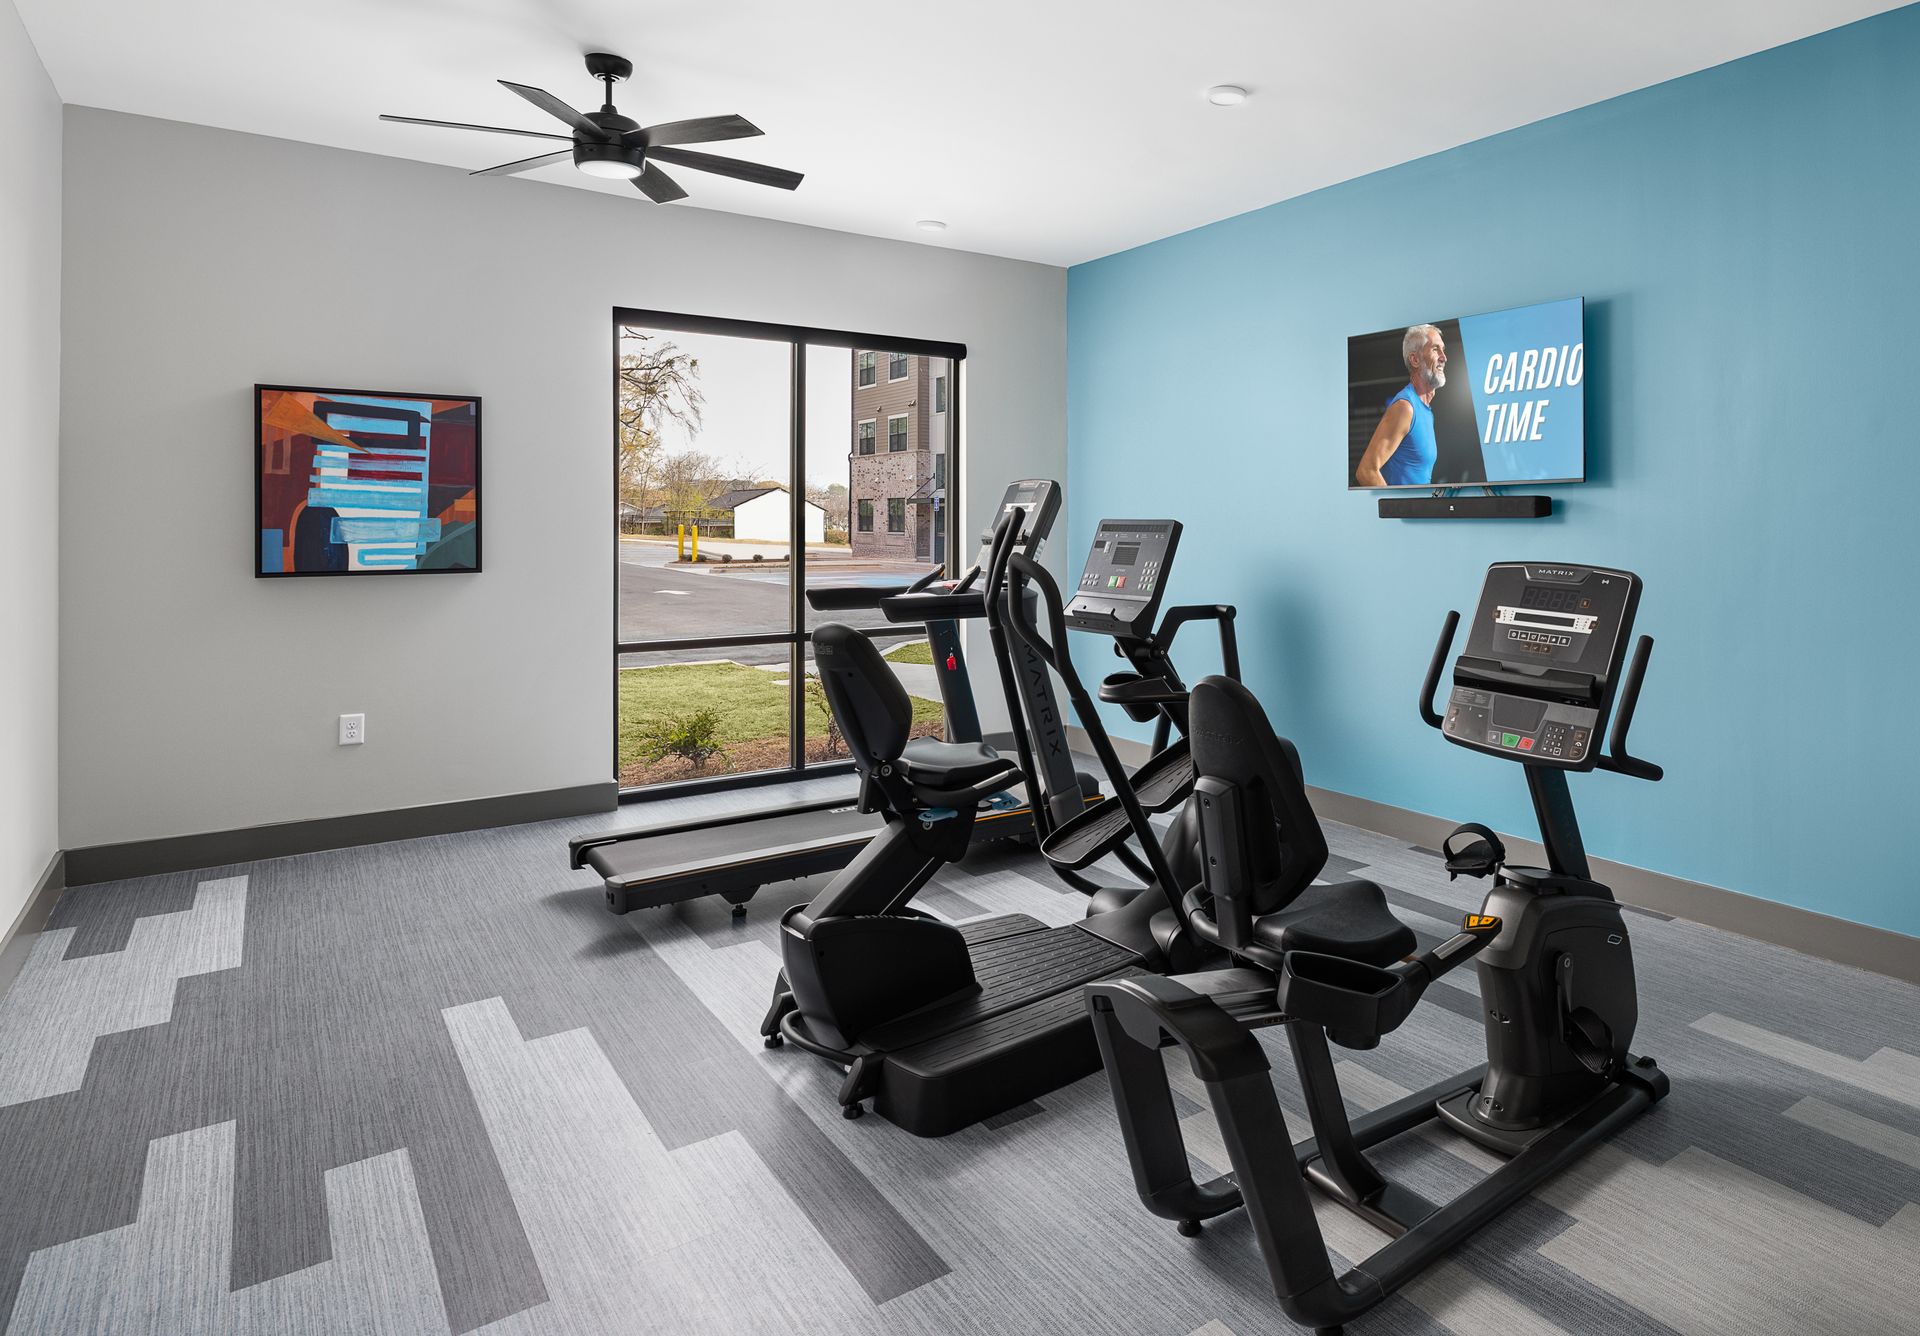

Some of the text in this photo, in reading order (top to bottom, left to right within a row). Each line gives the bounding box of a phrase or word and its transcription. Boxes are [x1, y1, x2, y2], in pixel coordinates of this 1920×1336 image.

[1484, 342, 1583, 395] CARDIO
[1484, 400, 1549, 444] TIME
[1024, 643, 1061, 757] MATRIX
